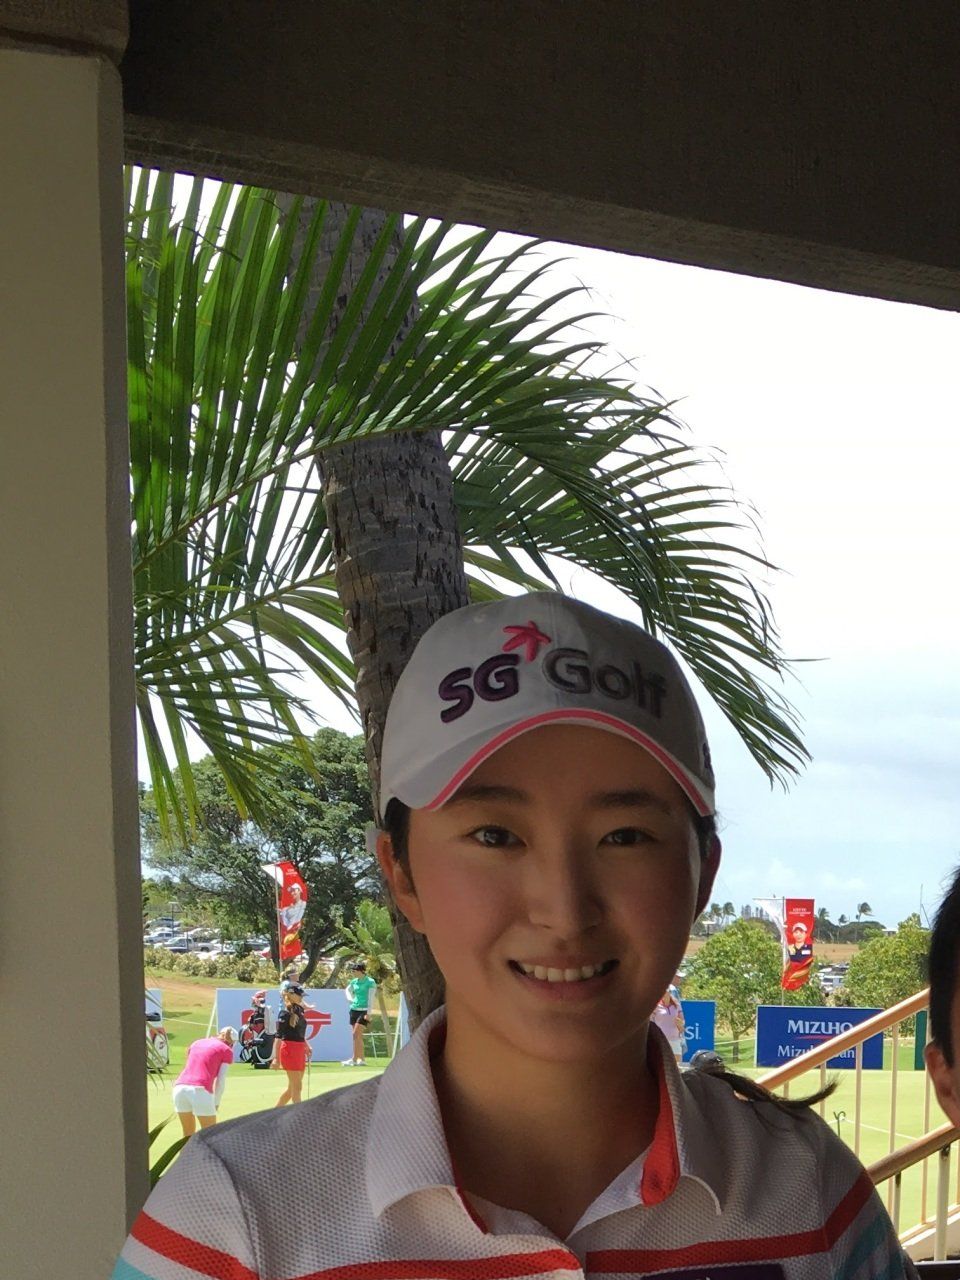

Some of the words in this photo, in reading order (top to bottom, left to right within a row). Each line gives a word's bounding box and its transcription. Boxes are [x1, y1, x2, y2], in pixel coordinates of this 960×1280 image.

[438, 653, 520, 723] SG
[541, 647, 667, 718] Golf
[787, 1019, 854, 1036] MIZUHO
[777, 1044, 815, 1058] Mizu
